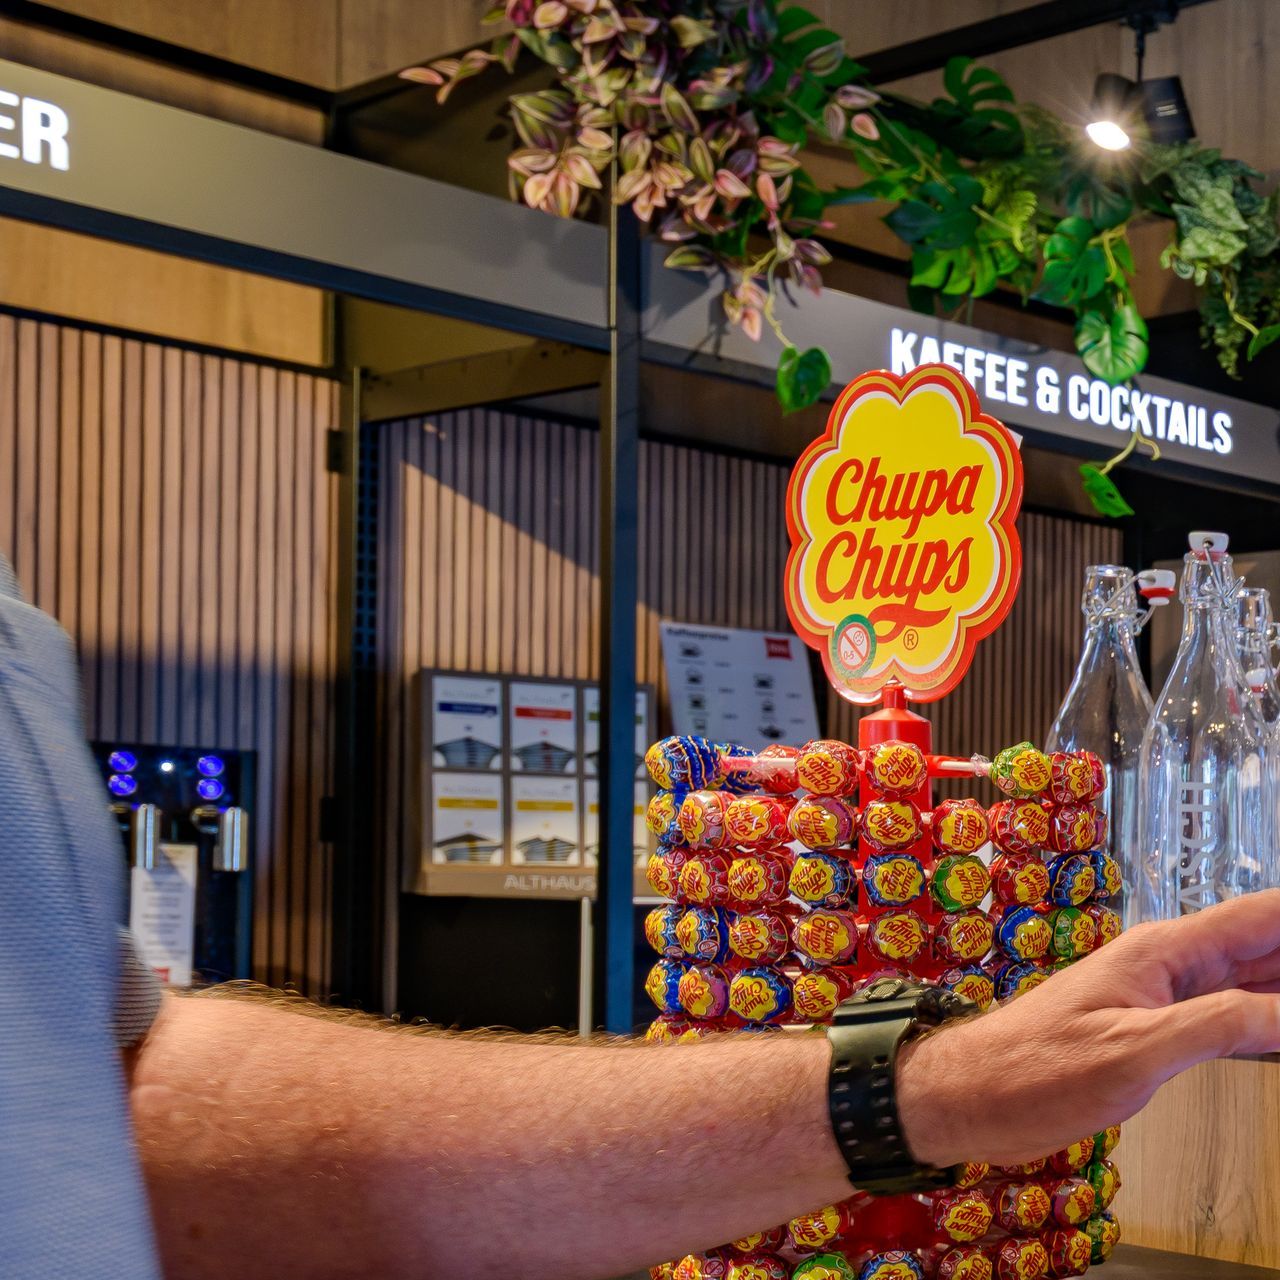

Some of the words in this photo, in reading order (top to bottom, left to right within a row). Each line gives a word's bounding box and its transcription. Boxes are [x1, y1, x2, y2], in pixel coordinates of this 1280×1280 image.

[890, 328, 1029, 407] KAFFEE
[1035, 367, 1060, 414] &
[1068, 374, 1233, 455] COCKTAILS
[826, 456, 983, 539] Chupa
[815, 527, 974, 643] Chups
[504, 874, 596, 891] ALTHAUS
